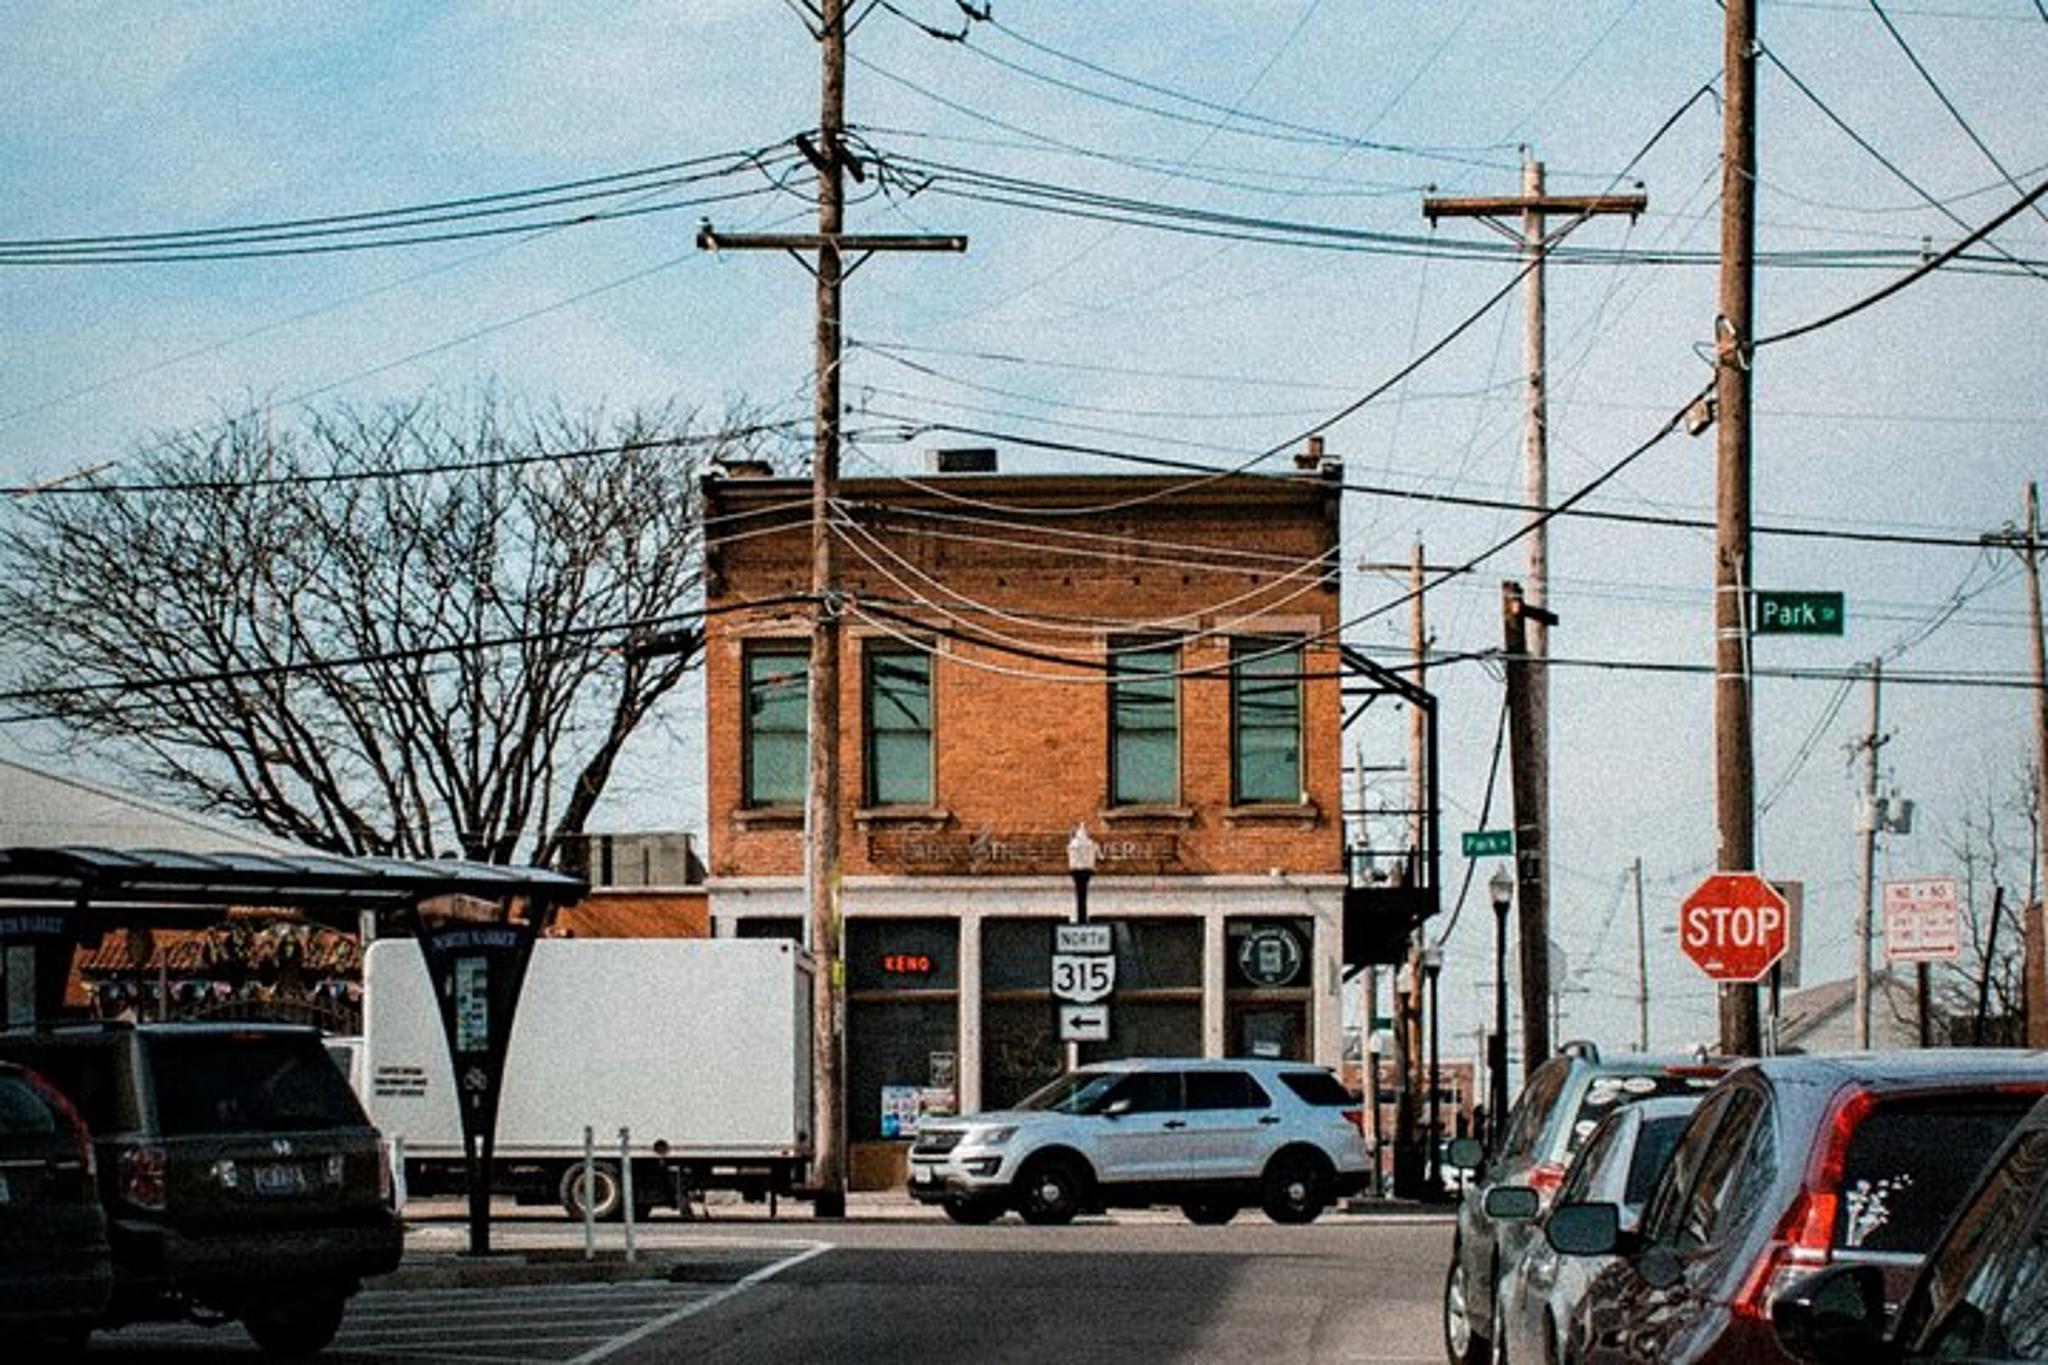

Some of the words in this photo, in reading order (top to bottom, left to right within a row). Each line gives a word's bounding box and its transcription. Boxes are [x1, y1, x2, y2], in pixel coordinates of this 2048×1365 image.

[1763, 601, 1816, 626] Park
[1060, 931, 1108, 945] NORTH
[1686, 907, 1780, 948] STOP
[884, 955, 930, 972] KENO
[1057, 963, 1109, 992] 315
